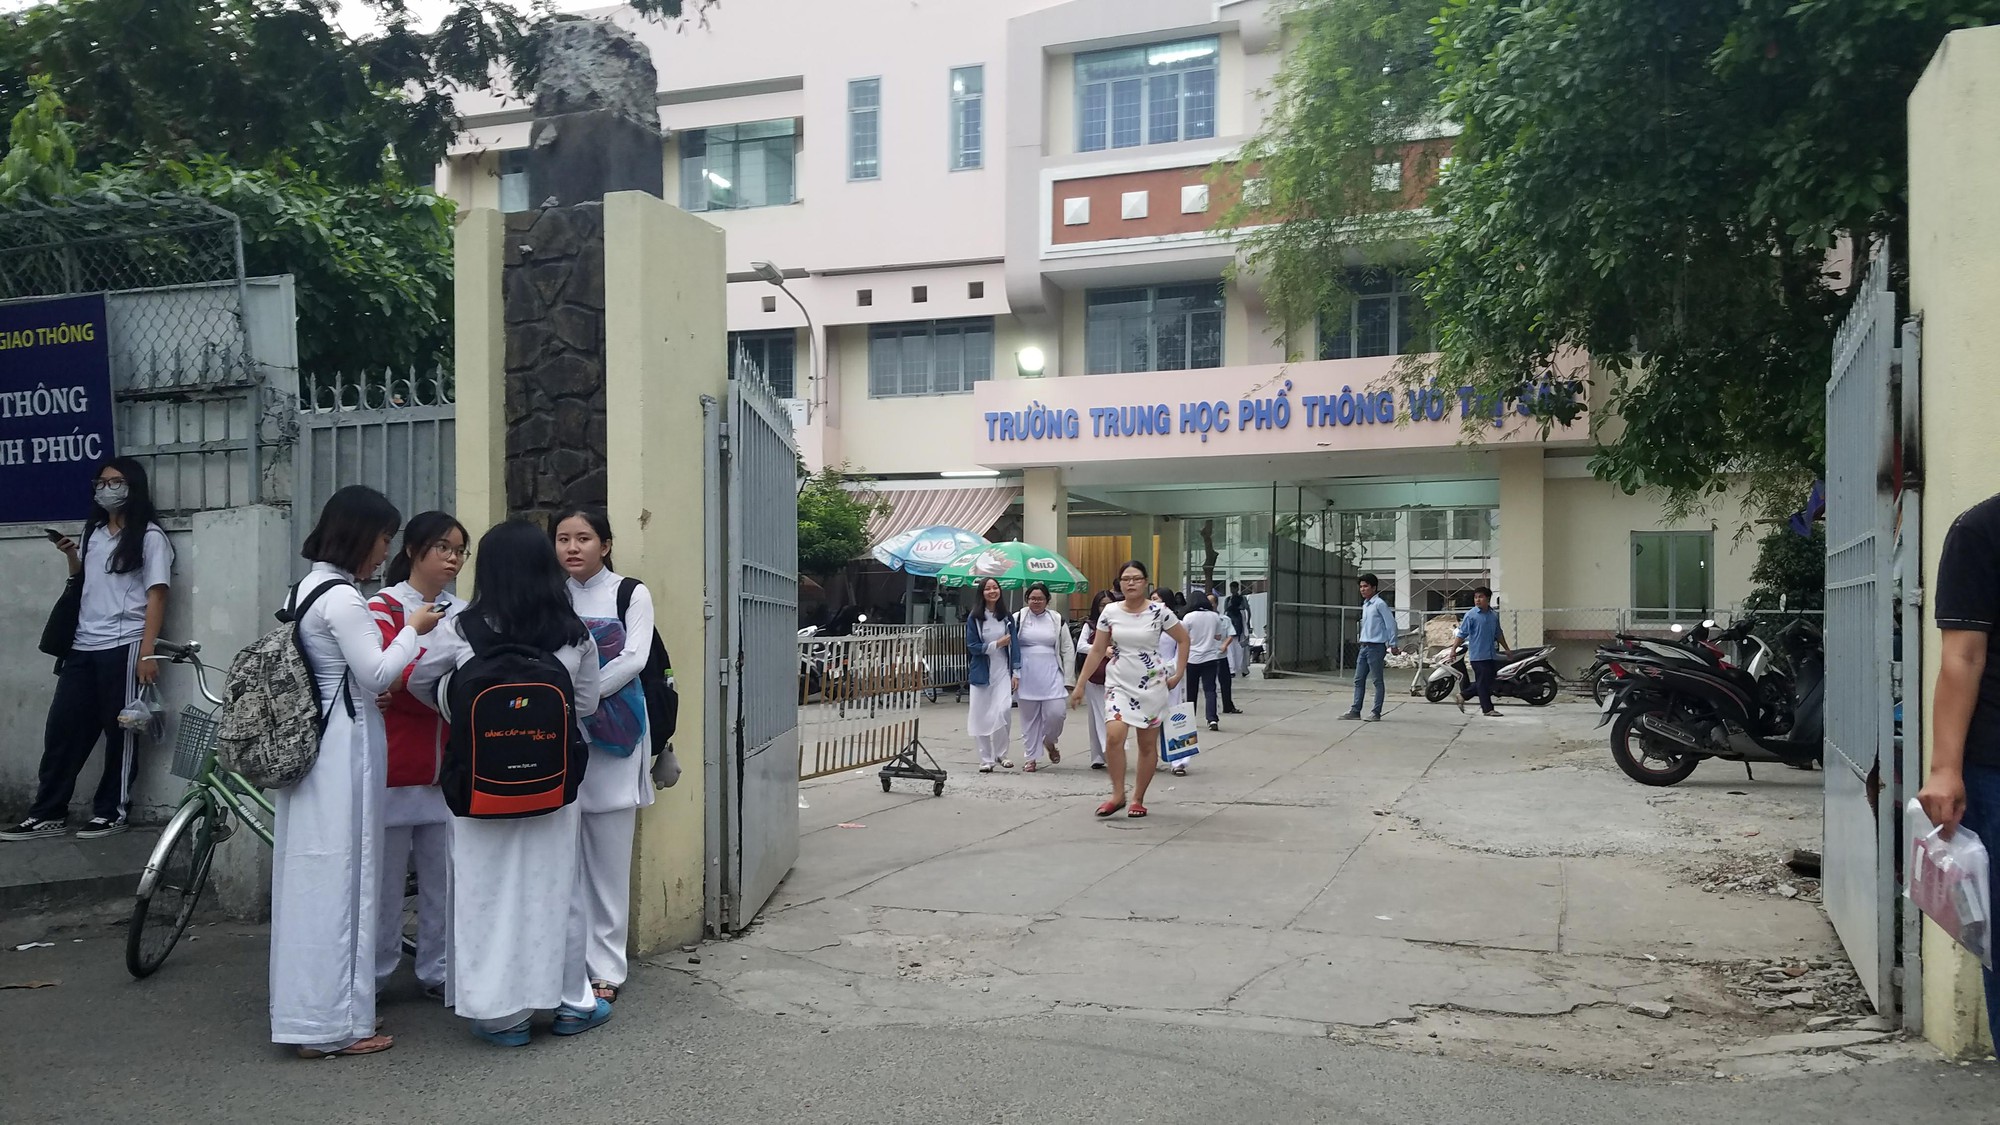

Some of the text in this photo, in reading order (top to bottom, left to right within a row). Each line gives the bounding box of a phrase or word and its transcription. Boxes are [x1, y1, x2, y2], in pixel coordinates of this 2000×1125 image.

[36, 322, 95, 346] THÔNG
[0, 381, 89, 418] THÔNG
[984, 399, 1080, 442] TRƯỜNG
[1089, 403, 1172, 438] TRUNG
[1179, 400, 1230, 443] HỌC
[1238, 379, 1293, 431] PHỔ
[1302, 385, 1395, 428] THÔNG
[31, 426, 102, 464] PHÚC
[1030, 561, 1055, 570] MILO
